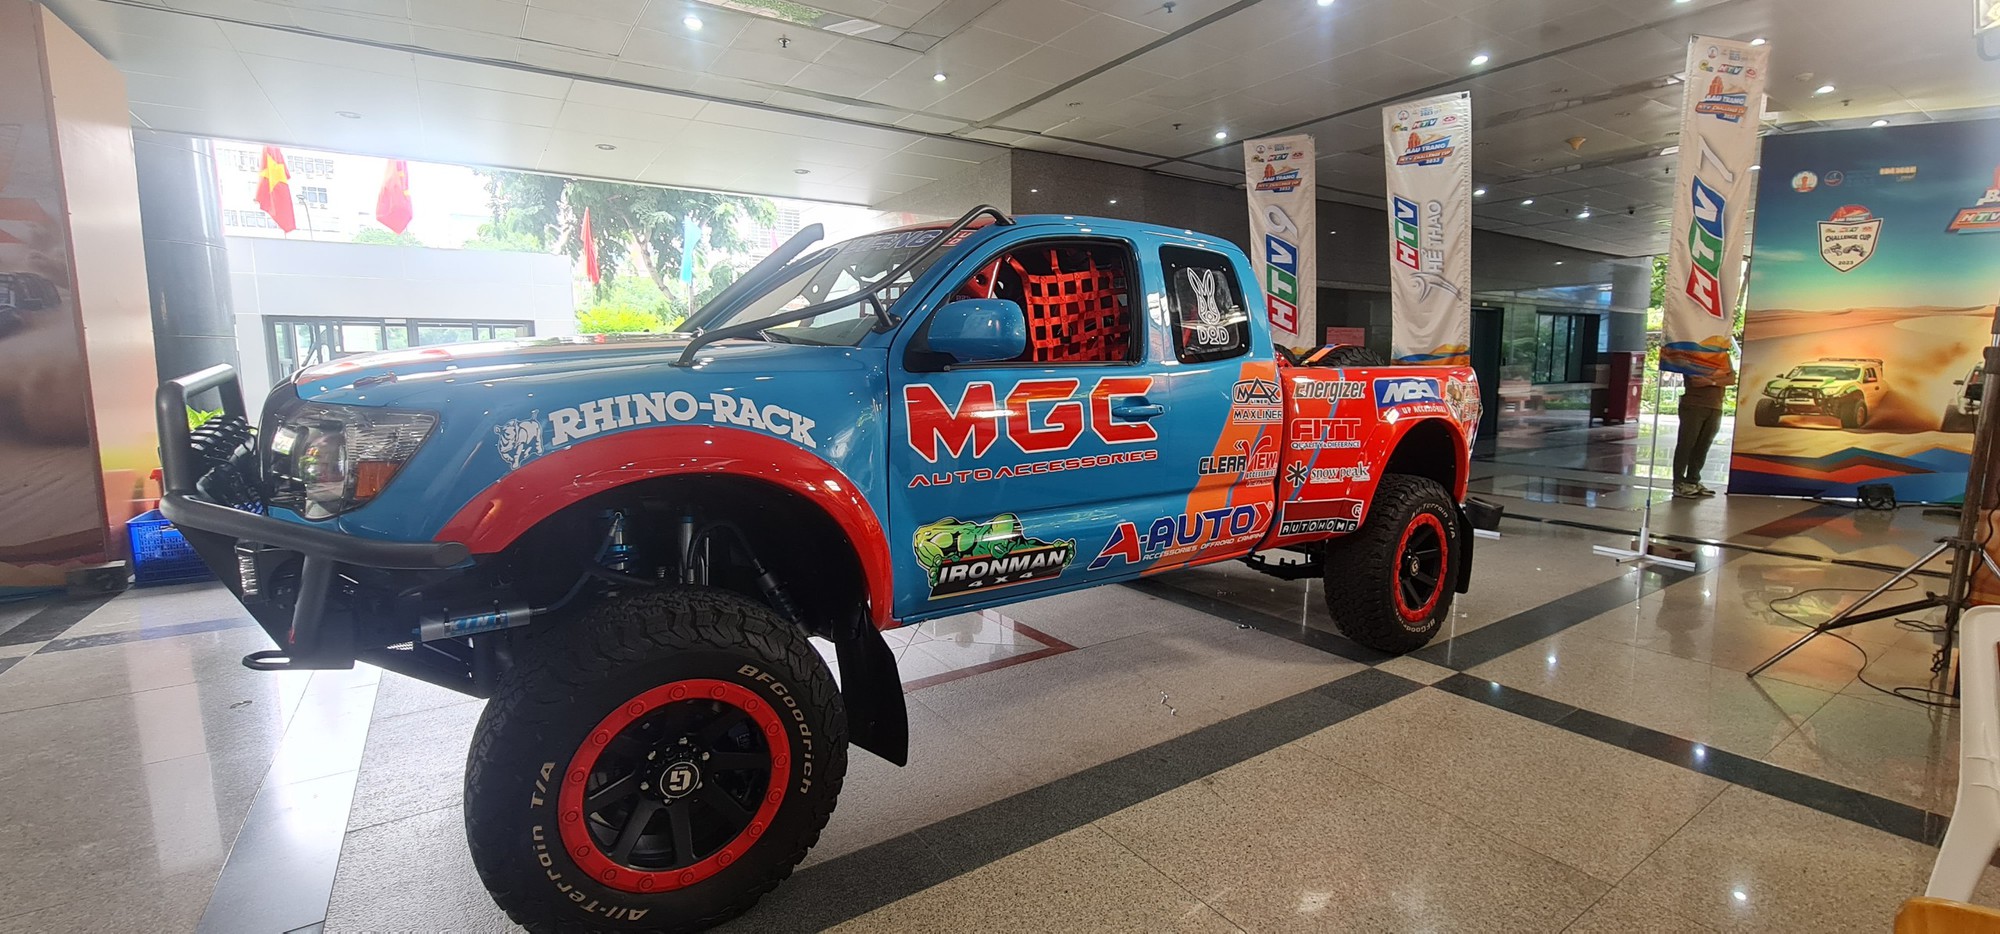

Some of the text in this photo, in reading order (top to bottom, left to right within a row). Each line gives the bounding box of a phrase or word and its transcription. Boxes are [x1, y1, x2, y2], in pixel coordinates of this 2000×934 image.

[1412, 118, 1438, 130] HTV
[1394, 195, 1420, 271] HTV
[1825, 233, 1872, 243] CHALLENGE CUP
[1197, 325, 1230, 345] DOD
[1294, 377, 1366, 404] Energizer
[548, 391, 817, 449] RHINO-RACK
[903, 376, 1158, 463] MGC
[1233, 409, 1282, 420] MAXLINER
[1290, 418, 1361, 440] FITT
[1311, 461, 1369, 481] snow peak
[1282, 520, 1356, 534] AUTOHOME
[1142, 545, 1197, 561] ACCESSORIES
[1200, 537, 1235, 551] OFFROAD
[938, 549, 1067, 585] IRONMAN
[737, 664, 814, 794] BFGoodrich
[530, 762, 557, 809] T/A
[531, 825, 650, 922] All-Terrain
